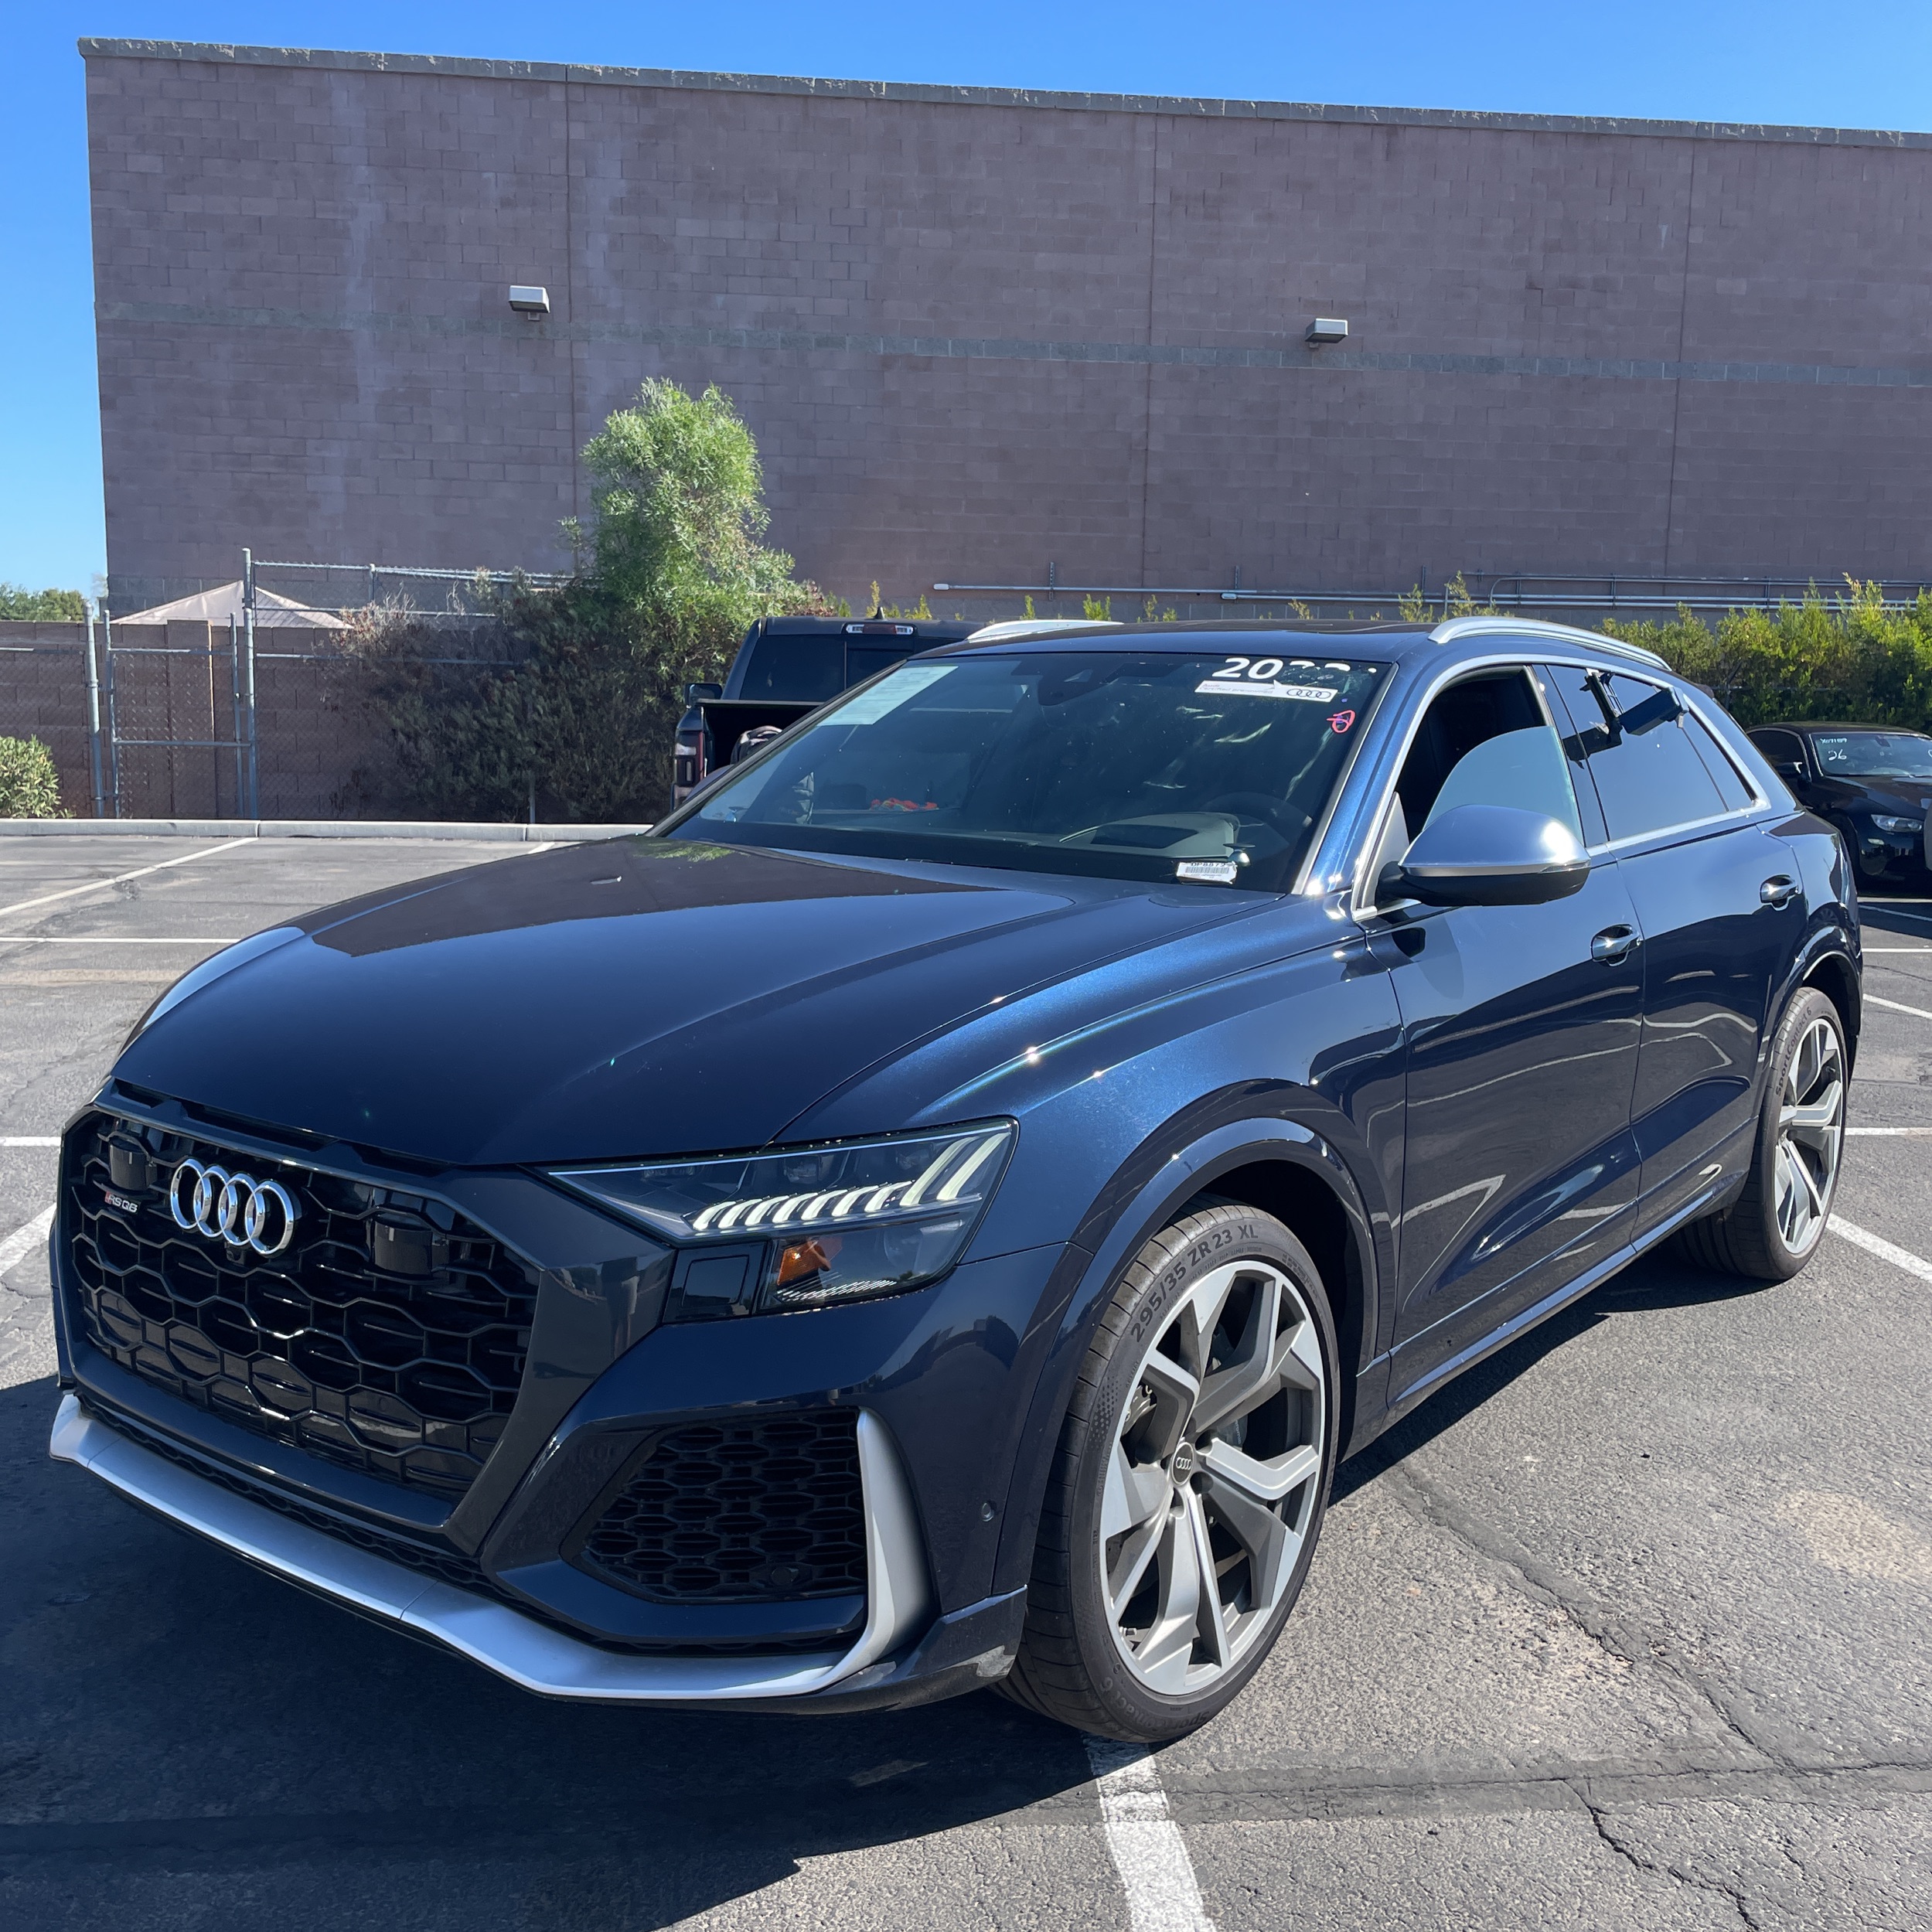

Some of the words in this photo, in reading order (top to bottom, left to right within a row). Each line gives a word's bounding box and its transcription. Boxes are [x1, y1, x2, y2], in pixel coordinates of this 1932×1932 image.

[1131, 1262, 1187, 1342] 295/35
[1187, 1241, 1211, 1267] ZR
[1212, 1229, 1233, 1249] 23
[1238, 1225, 1258, 1239] XL
